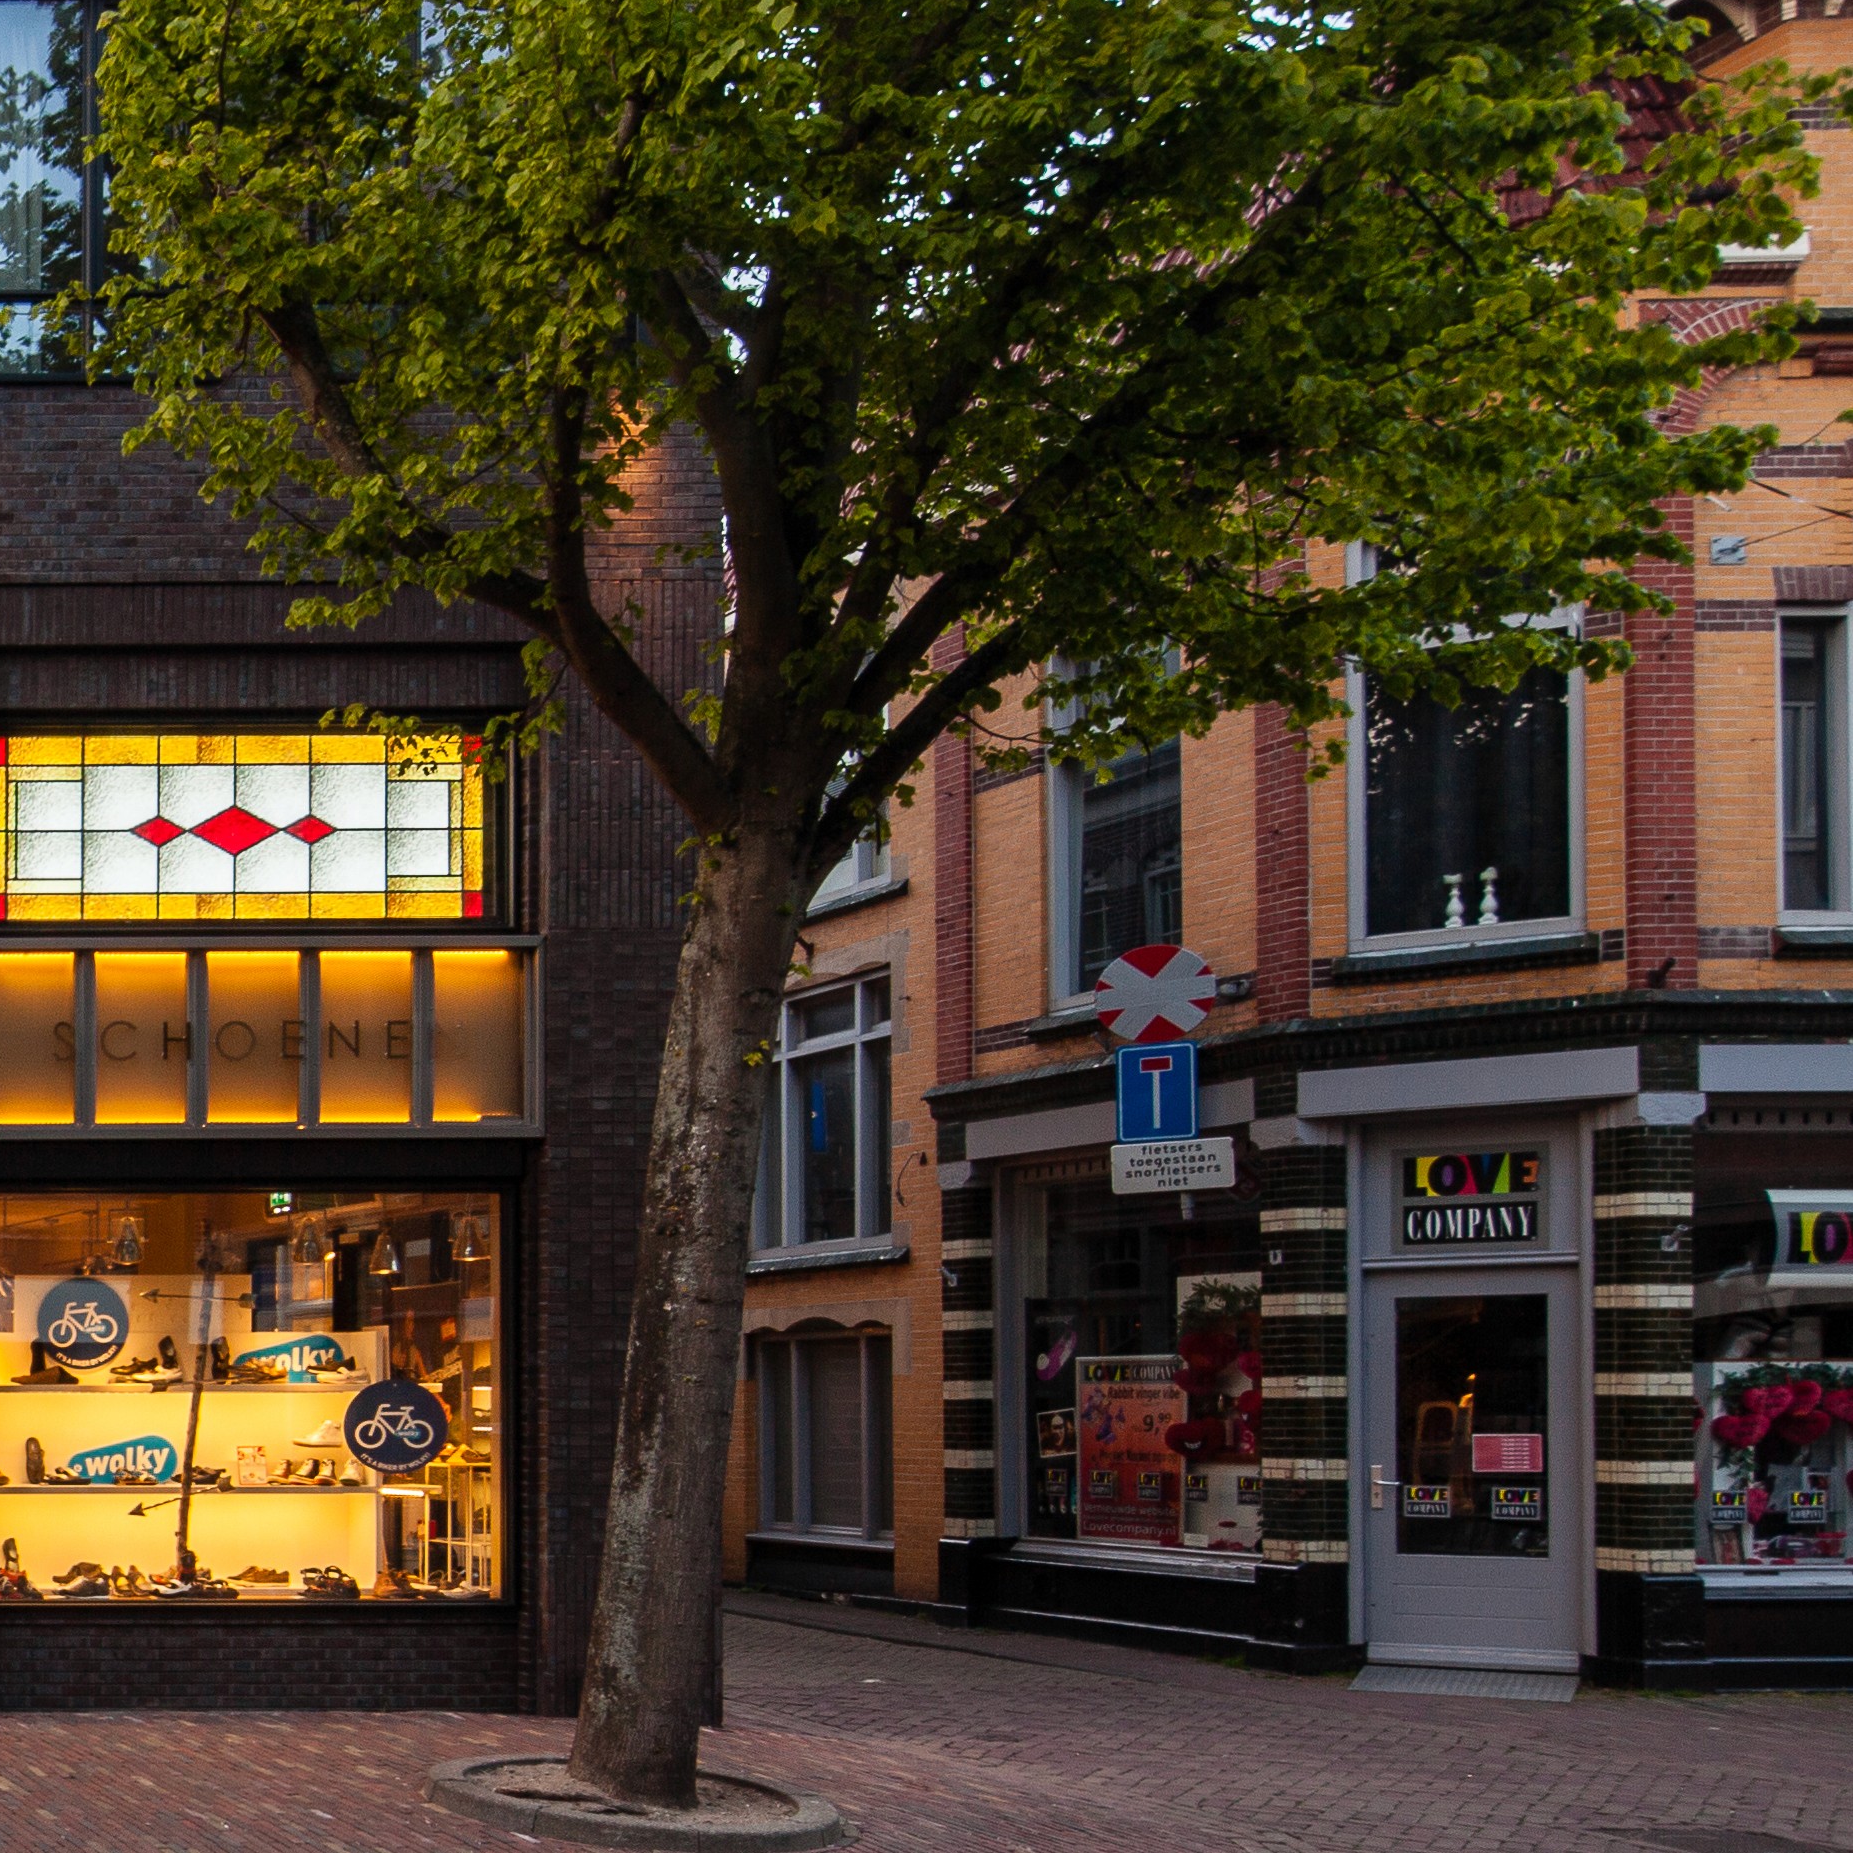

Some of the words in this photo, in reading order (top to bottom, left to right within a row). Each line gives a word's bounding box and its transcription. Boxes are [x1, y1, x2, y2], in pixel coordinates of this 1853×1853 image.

[1141, 1143, 1202, 1155] fietsers
[1129, 1153, 1217, 1167] toegestaan
[1125, 1164, 1221, 1179] snorfietsers
[1403, 1151, 1539, 1197] LOVE
[1157, 1176, 1189, 1187] niet
[1407, 1206, 1532, 1241] COMPANY
[265, 1345, 335, 1372] olky
[85, 1445, 170, 1477] wolky
[1407, 1487, 1448, 1500] LOVE
[1496, 1489, 1538, 1503] LOVE
[1083, 1521, 1176, 1537] Lovecompany.nl
